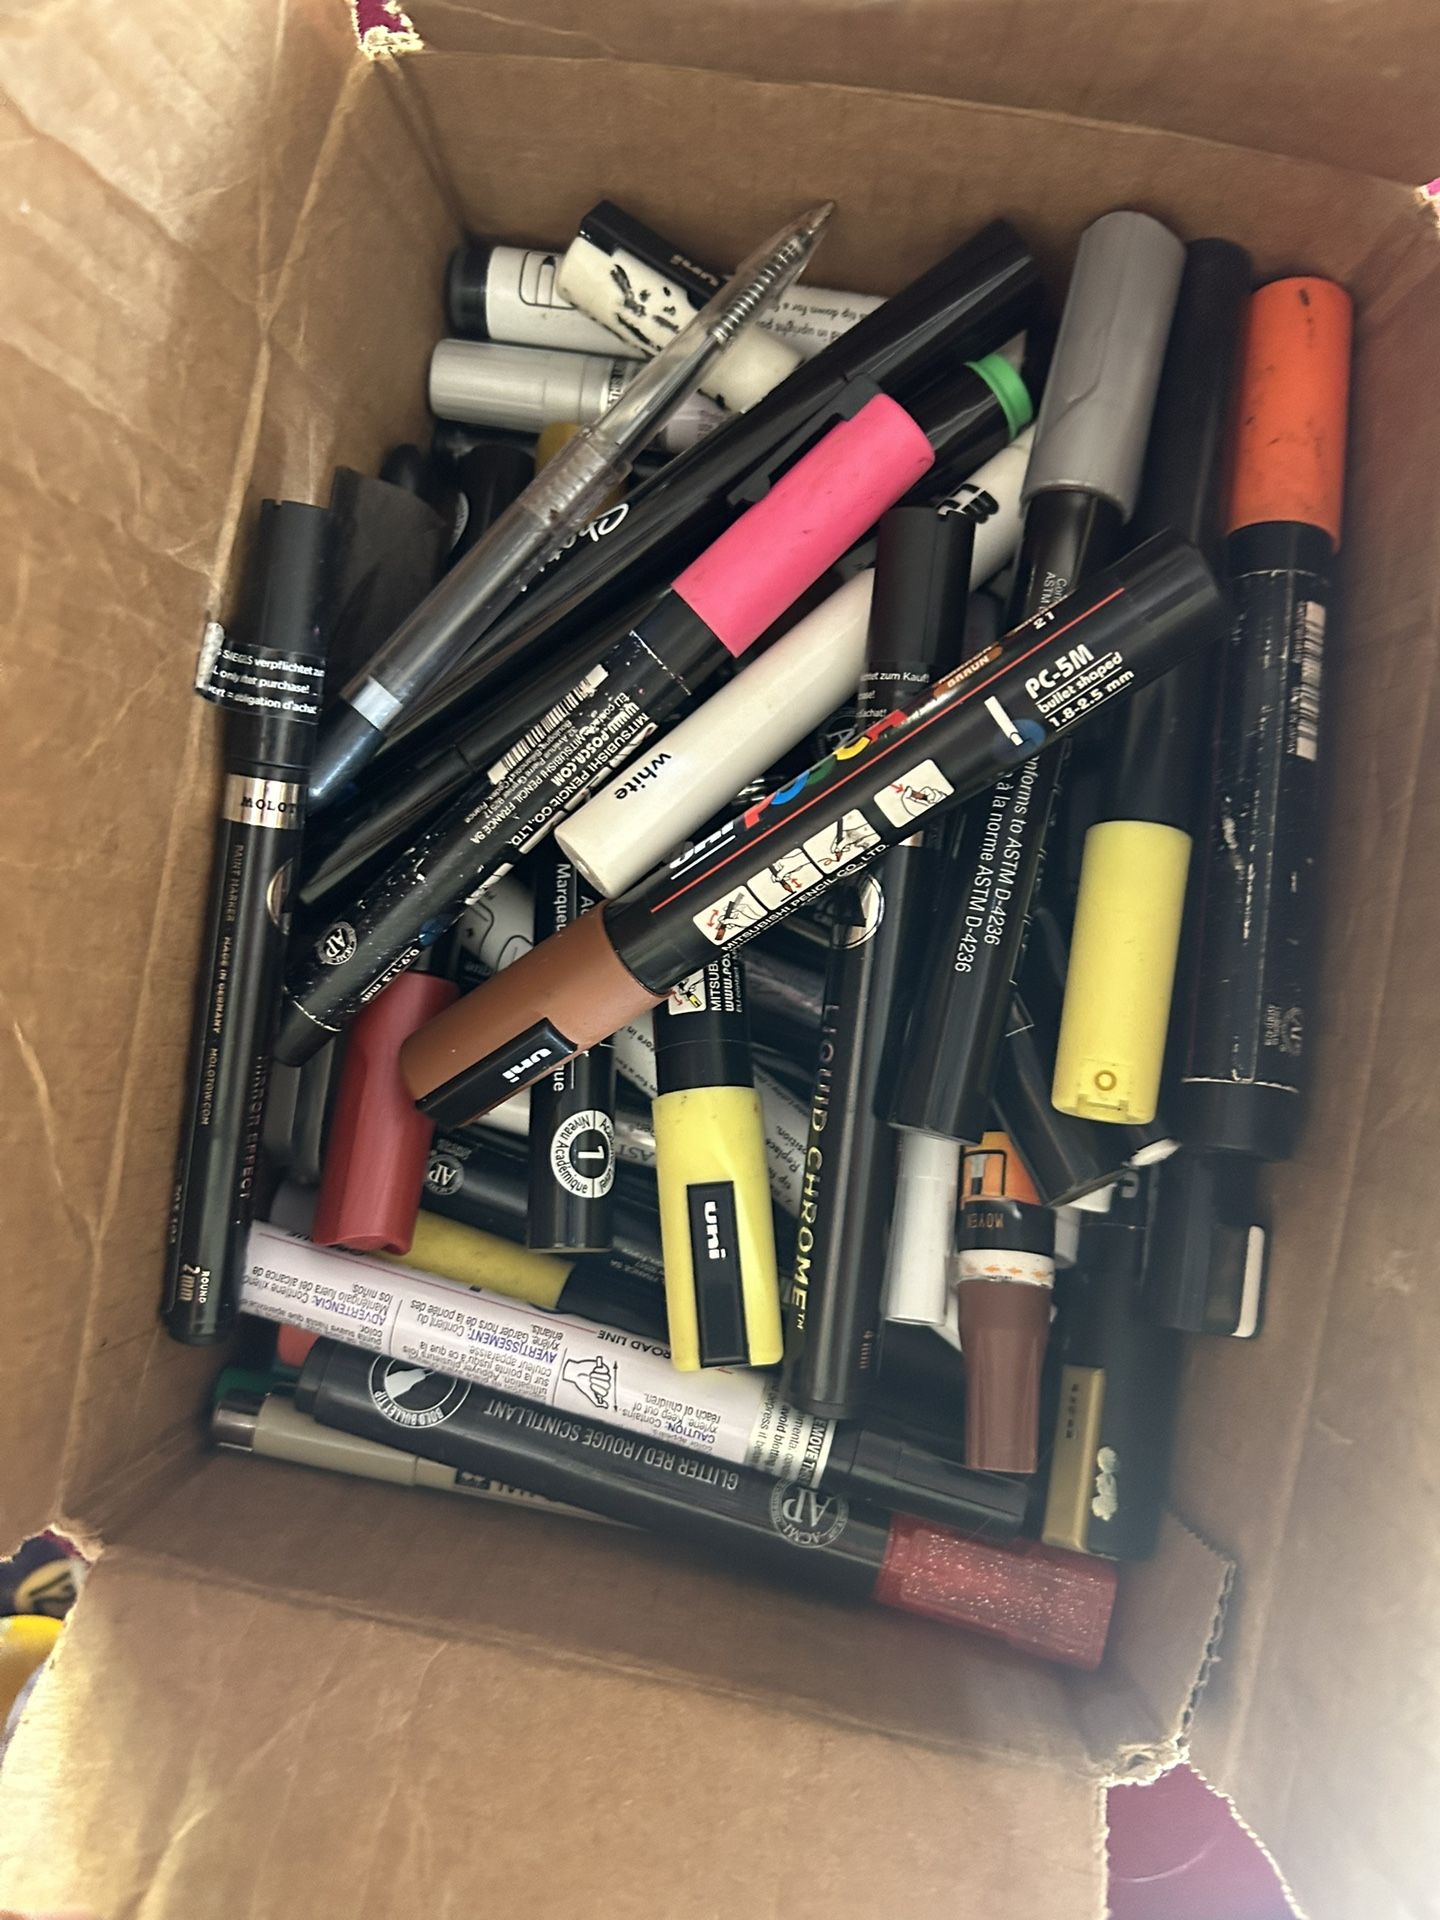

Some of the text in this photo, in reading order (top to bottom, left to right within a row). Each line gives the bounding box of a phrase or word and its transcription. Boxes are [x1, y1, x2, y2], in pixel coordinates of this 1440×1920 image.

[1040, 571, 1056, 604] ASTM
[879, 672, 900, 680] zum
[1022, 641, 1095, 699] PC-5M
[1037, 650, 1124, 714] bullet shaped
[258, 678, 310, 694] purchase!
[1048, 668, 1134, 729] 1.8-2.5 mm
[538, 732, 586, 778] MITSUBISHI
[587, 712, 649, 772] MITSUBISHI
[512, 774, 543, 805] PENCIL
[547, 769, 590, 809] PENCIL
[612, 749, 674, 805] white
[481, 800, 516, 834] FRANCE
[991, 794, 1009, 809] la
[469, 829, 485, 846] SA
[979, 811, 1003, 862] norme
[1007, 818, 1026, 834] to
[997, 836, 1022, 884] ASTM
[968, 864, 993, 911] ASTM
[721, 903, 791, 952] MITSUBISHI
[791, 874, 837, 907] PENCIL
[983, 887, 1011, 946] D-4236
[220, 936, 232, 967] MADE
[953, 915, 982, 973] D-4236
[218, 968, 228, 980] IN
[380, 946, 421, 984] 0.9-1.3
[211, 982, 226, 1033] GERMANY
[503, 1048, 552, 1085] uni
[809, 1005, 841, 1132] LIQUID
[199, 1047, 218, 1125] MOLOTOW.COM
[238, 1131, 259, 1200] EFFECT
[555, 1114, 591, 1194] Niveau Académique
[578, 1145, 604, 1159] 1
[704, 1201, 727, 1260] uni
[200, 1270, 210, 1304] ROUND
[251, 1265, 389, 1315] Manténgalo fuera del alcance de
[269, 1282, 310, 1303] Contiene
[378, 1291, 393, 1304] los
[310, 1293, 386, 1326] ADVERTENCIA:
[409, 1299, 426, 1313] des
[416, 1313, 428, 1325] du
[427, 1303, 455, 1321] portée
[455, 1313, 464, 1324] la
[465, 1315, 477, 1328] de
[358, 1323, 383, 1338] color.
[429, 1316, 465, 1337] Contient
[478, 1319, 499, 1334] hors
[499, 1325, 529, 1343] Garder
[529, 1323, 563, 1341] enfants.
[597, 1329, 626, 1345] LINE
[418, 1340, 427, 1351] la
[430, 1343, 446, 1355] que
[448, 1349, 459, 1359] ce
[466, 1327, 557, 1364] AVERTISSEMENT:
[493, 1361, 522, 1379] pointe
[517, 1359, 552, 1378] couleur
[523, 1371, 533, 1382] la
[534, 1375, 549, 1386] sur
[372, 1388, 445, 1429] BOLD BULLET TIP
[483, 1396, 581, 1442] SCINTILLANT
[632, 1401, 642, 1412] of
[642, 1392, 720, 1424] reach of children.
[643, 1405, 659, 1416] out
[660, 1408, 684, 1425] Keep
[620, 1407, 715, 1444] CAUTION: Contains
[582, 1427, 635, 1458] ROUGE
[643, 1446, 676, 1470] RED
[676, 1456, 740, 1490] GLITTER
